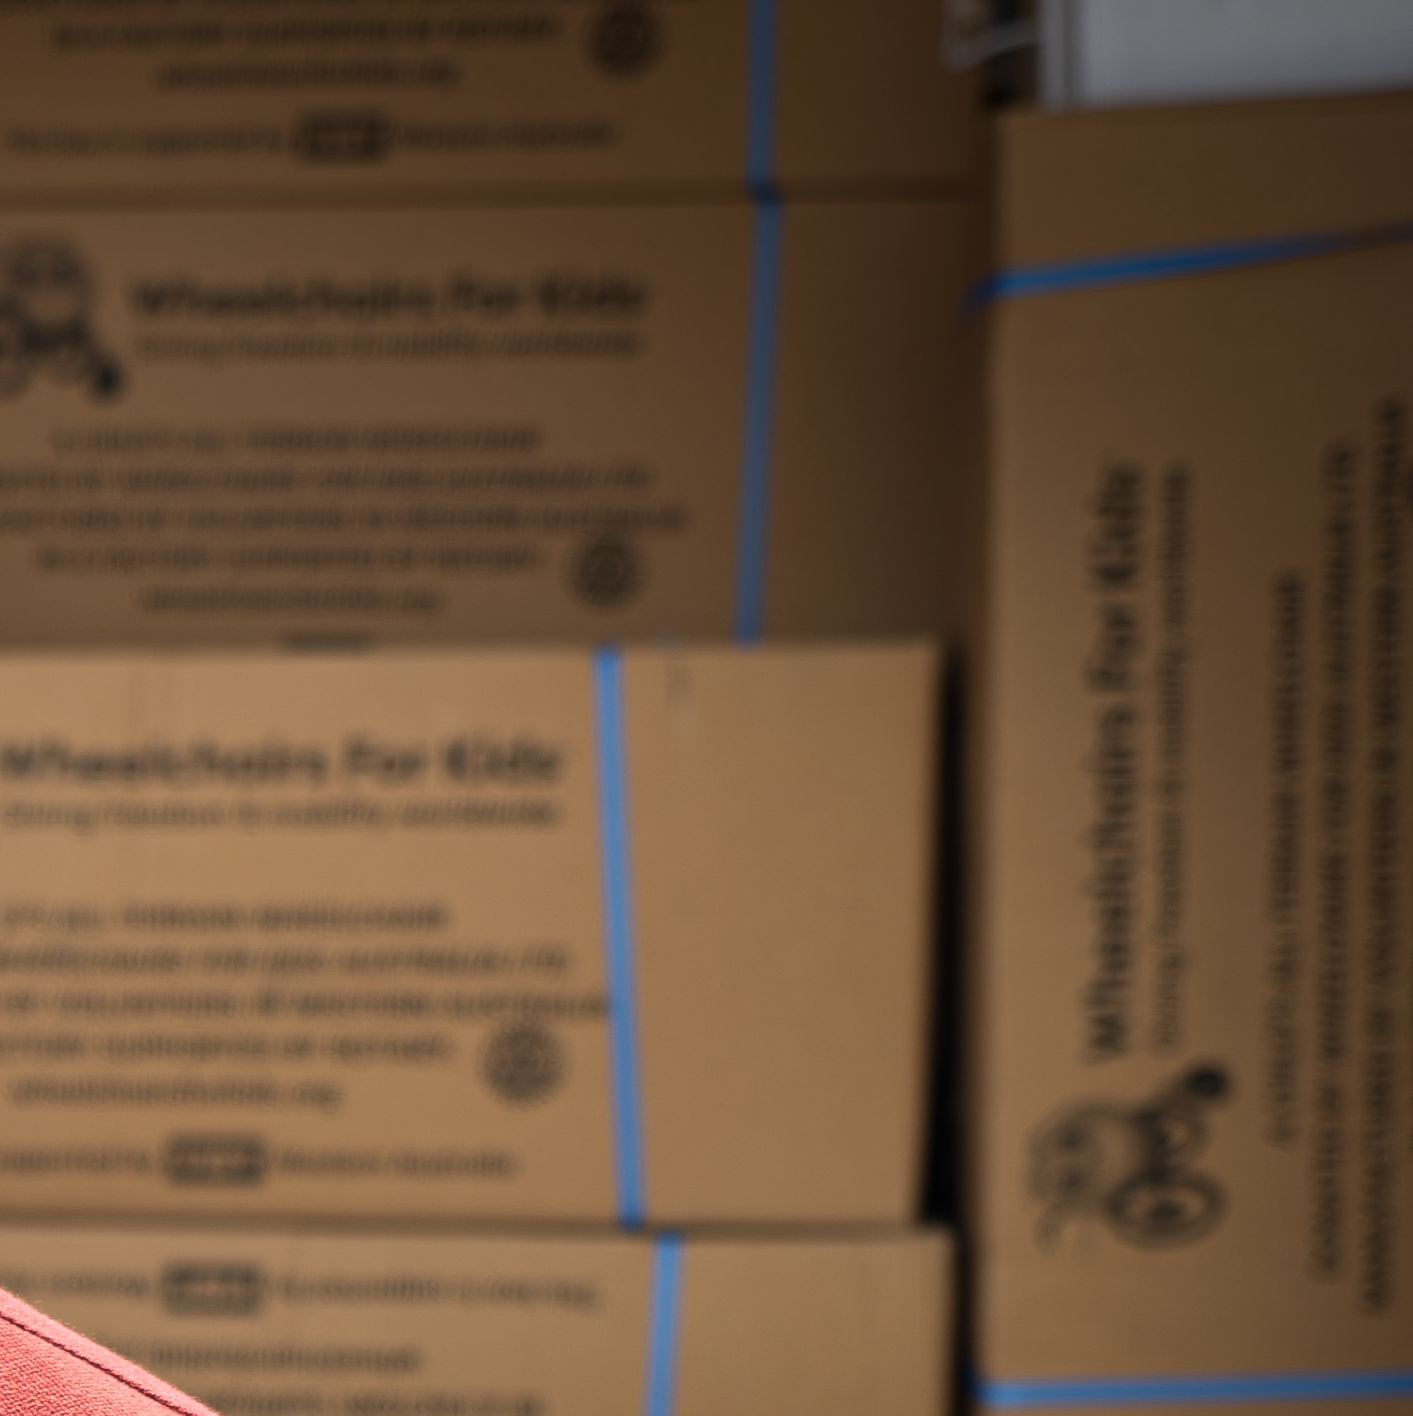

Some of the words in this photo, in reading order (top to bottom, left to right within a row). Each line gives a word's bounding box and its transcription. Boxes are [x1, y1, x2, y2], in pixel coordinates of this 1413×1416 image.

[1086, 462, 1144, 588] Kids
[1086, 604, 1141, 690] For
[341, 734, 434, 785] For
[440, 732, 566, 785] Kids
[1082, 704, 1139, 1059] Wheelchairs
